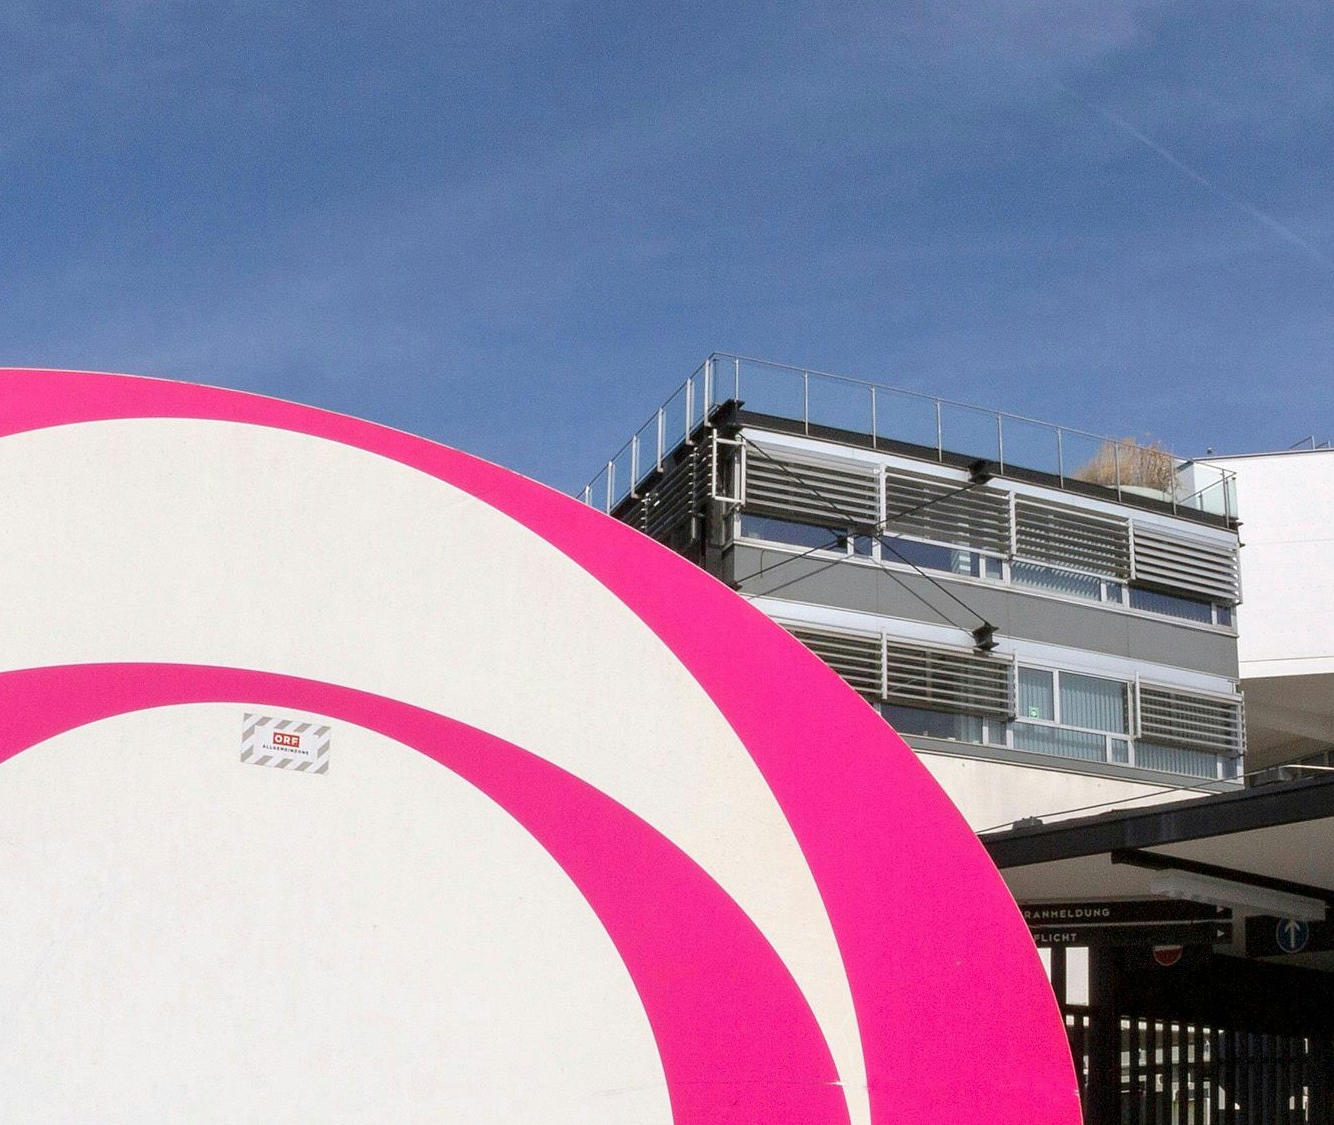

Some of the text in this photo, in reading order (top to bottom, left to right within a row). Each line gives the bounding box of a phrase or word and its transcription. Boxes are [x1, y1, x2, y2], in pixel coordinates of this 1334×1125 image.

[274, 734, 299, 746] ORF
[1024, 908, 1110, 919] RANMELDUNG
[1033, 933, 1077, 942] FLICHT
